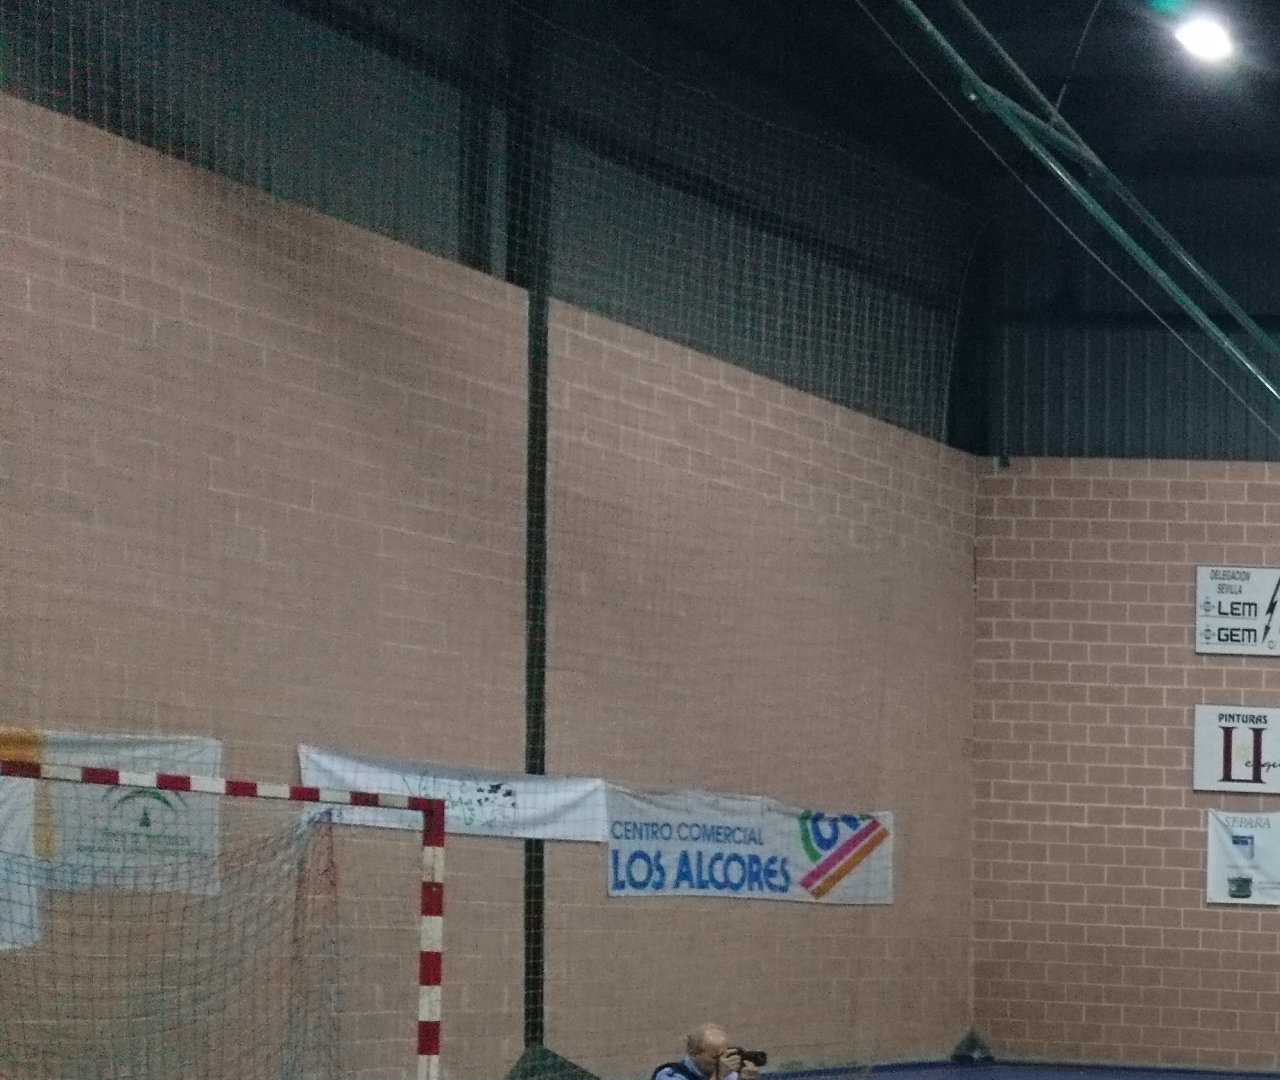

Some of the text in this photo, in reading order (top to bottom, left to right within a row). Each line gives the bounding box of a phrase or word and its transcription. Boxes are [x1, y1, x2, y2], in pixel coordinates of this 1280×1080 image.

[1218, 601, 1257, 617] LEM
[1218, 627, 1257, 643] GEM
[1218, 713, 1268, 724] PINTURAS
[1224, 816, 1271, 829] SEPARA
[610, 820, 764, 845] CENTRO COMERCIAL
[611, 849, 790, 893] LOS ALCORES
